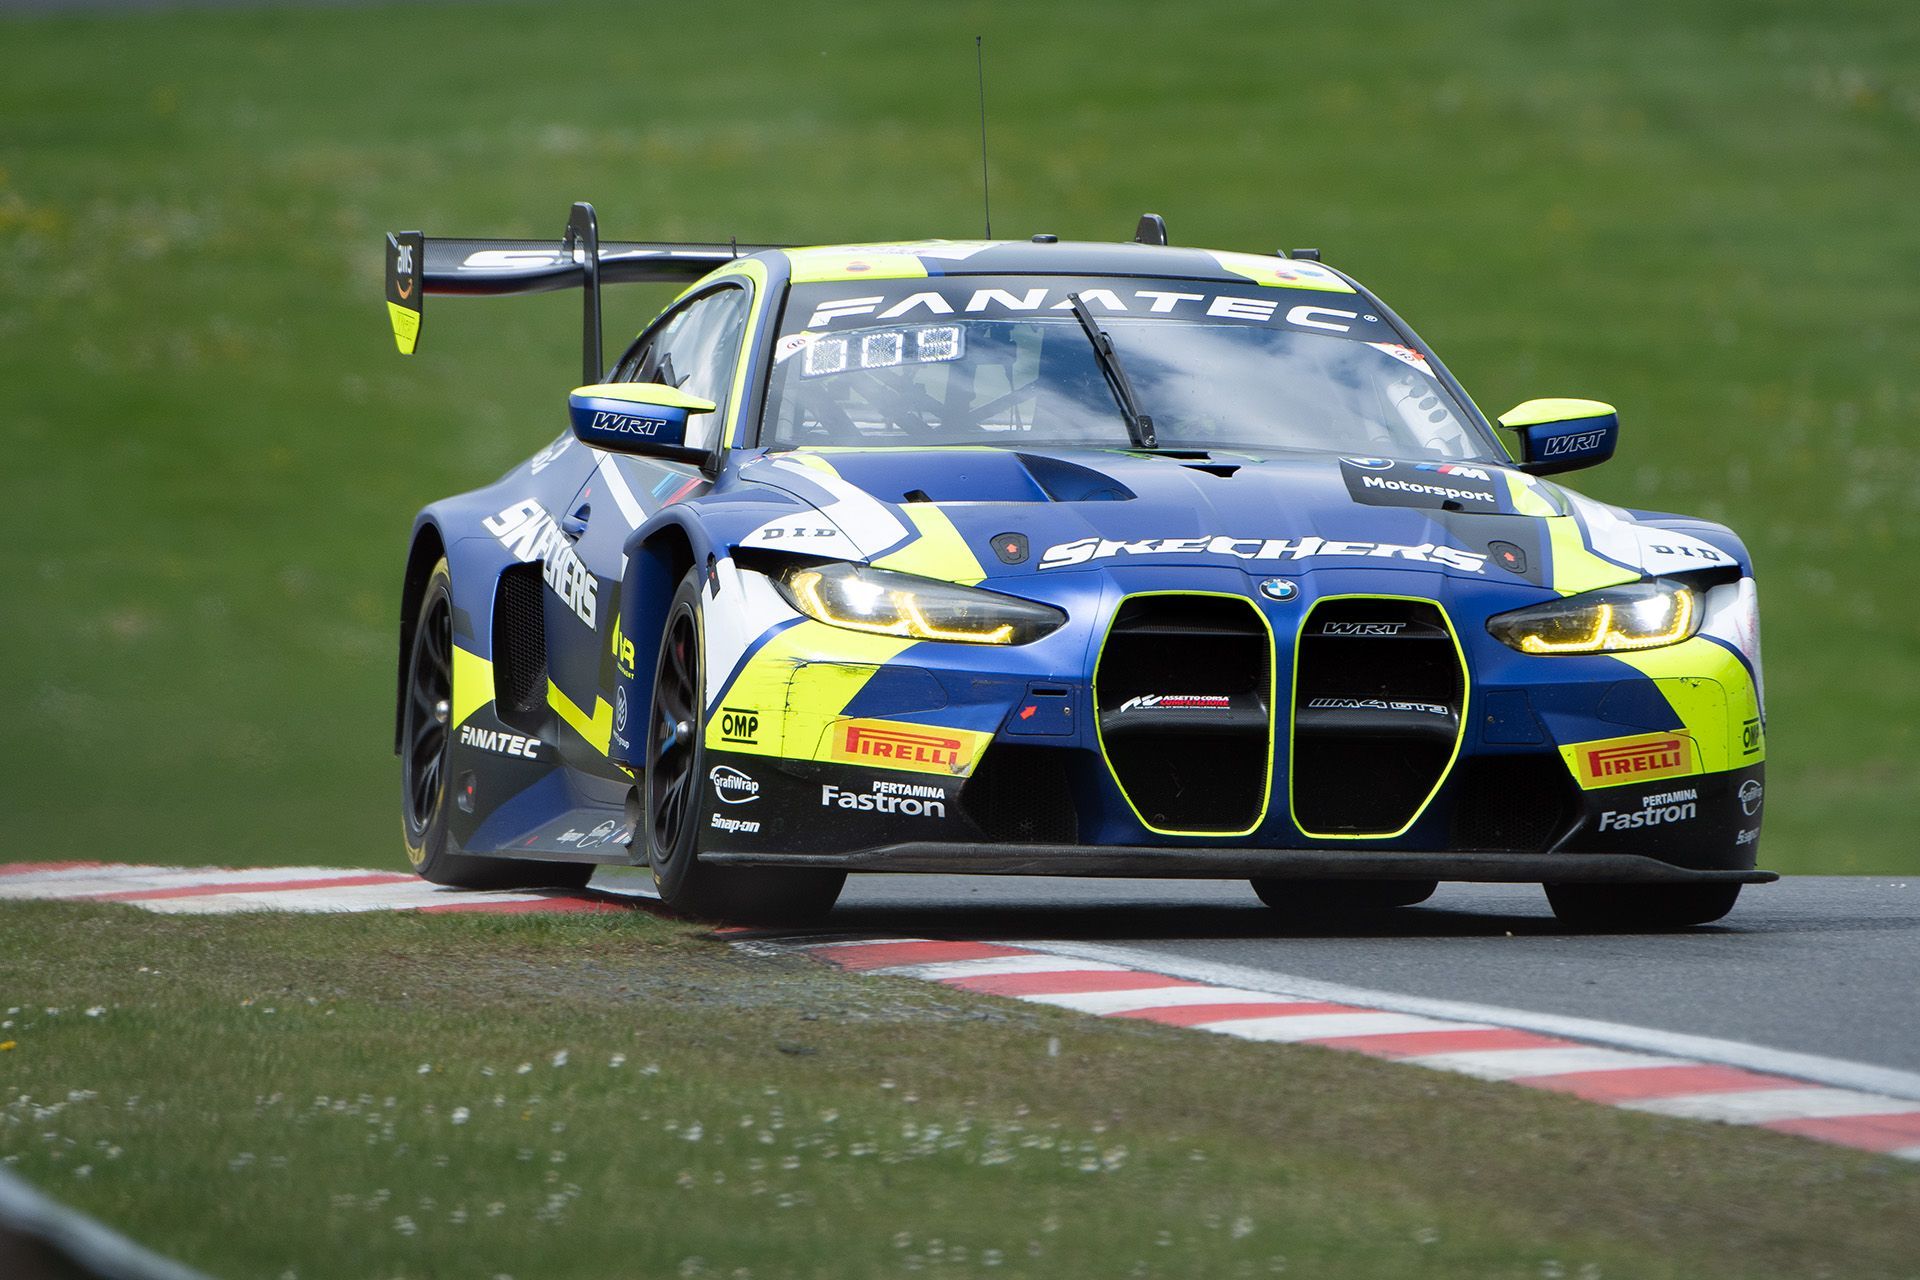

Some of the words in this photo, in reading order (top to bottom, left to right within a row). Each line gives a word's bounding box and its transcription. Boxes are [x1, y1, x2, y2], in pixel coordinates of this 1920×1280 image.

[808, 288, 1358, 333] FANATEC
[592, 411, 666, 435] WRT
[1544, 428, 1606, 455] WRT
[1361, 475, 1495, 502] Motorsport
[482, 497, 598, 630] SKECHERS
[1037, 535, 1486, 573] SKECHERS
[1322, 622, 1407, 635] WRT
[1389, 701, 1449, 715] GT3
[722, 714, 758, 738] OMP
[460, 725, 541, 758] FANATEC
[845, 726, 961, 765] PIRELLI
[1588, 740, 1681, 777] PIRELLI
[713, 775, 759, 794] GrafiWrap
[873, 780, 945, 799] PERTAMINA
[1643, 789, 1697, 807] PERTAMINA
[821, 784, 946, 818] Fastron
[711, 813, 760, 833] Snap-on
[1598, 802, 1697, 832] Fastron
